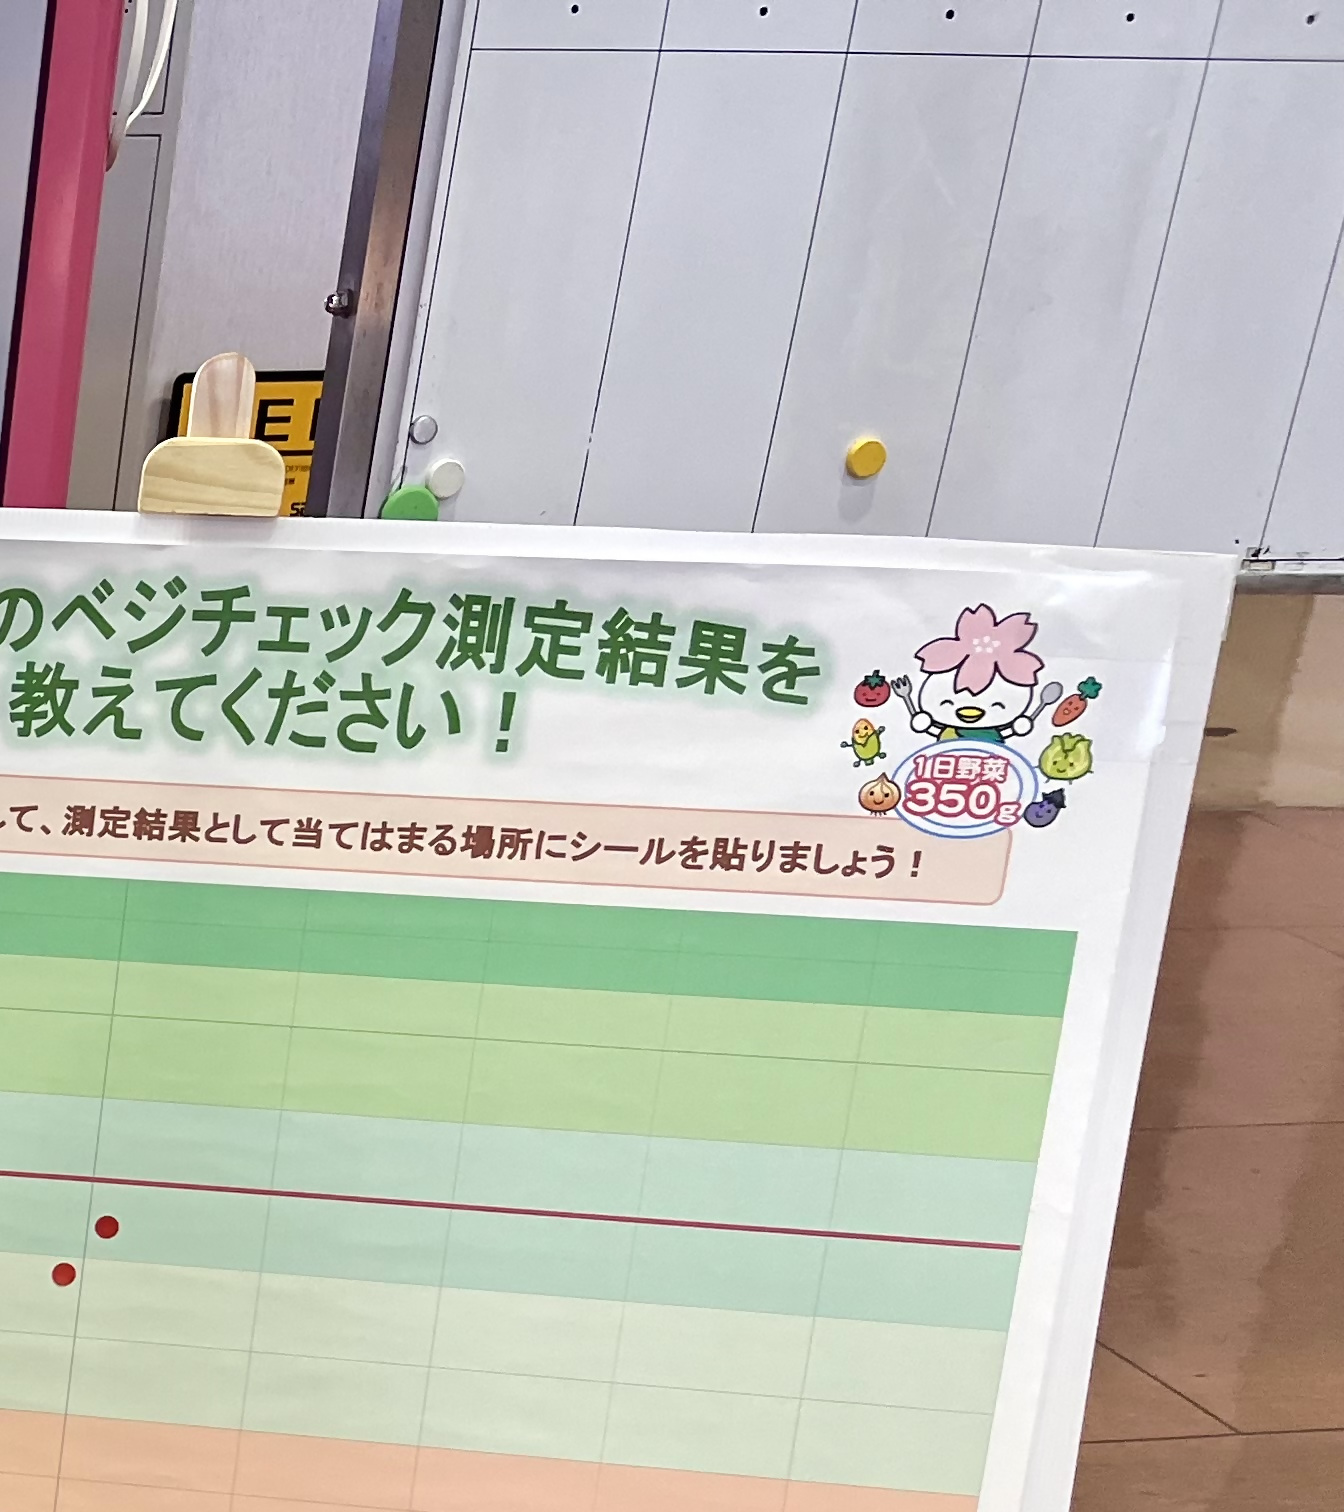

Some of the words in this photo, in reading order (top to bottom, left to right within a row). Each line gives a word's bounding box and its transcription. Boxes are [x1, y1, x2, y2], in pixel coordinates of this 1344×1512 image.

[8, 660, 518, 753] 教えてください！
[903, 779, 1021, 827] 350g
